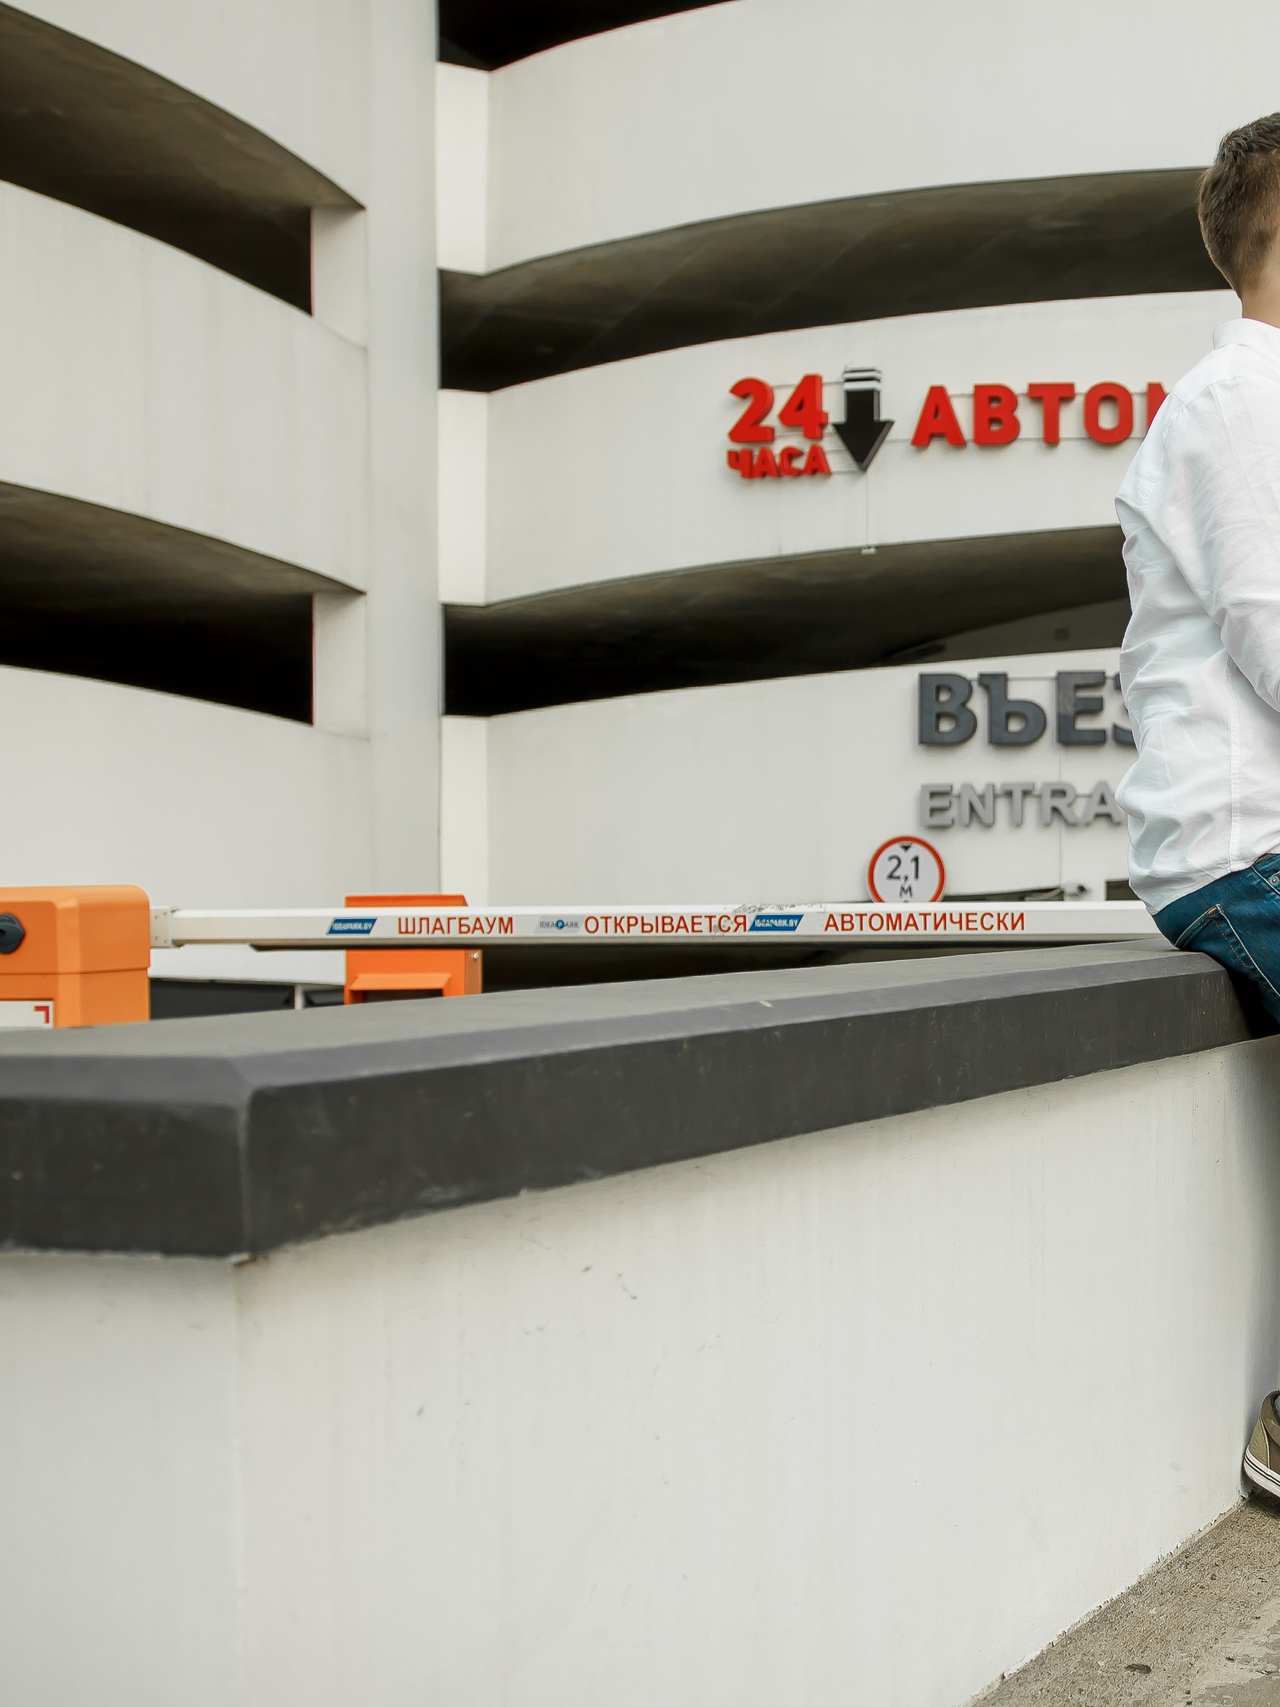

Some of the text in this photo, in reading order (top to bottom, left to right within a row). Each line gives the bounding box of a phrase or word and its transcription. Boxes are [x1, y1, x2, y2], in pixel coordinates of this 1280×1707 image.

[728, 374, 829, 443] 24
[726, 443, 832, 479] ЧАСА
[886, 855, 919, 882] 2,1
[398, 912, 1025, 935] ШЛАГБАУМ ОТКРЫВАЕТСЯ АВТОМАТИЧЕСКИ
